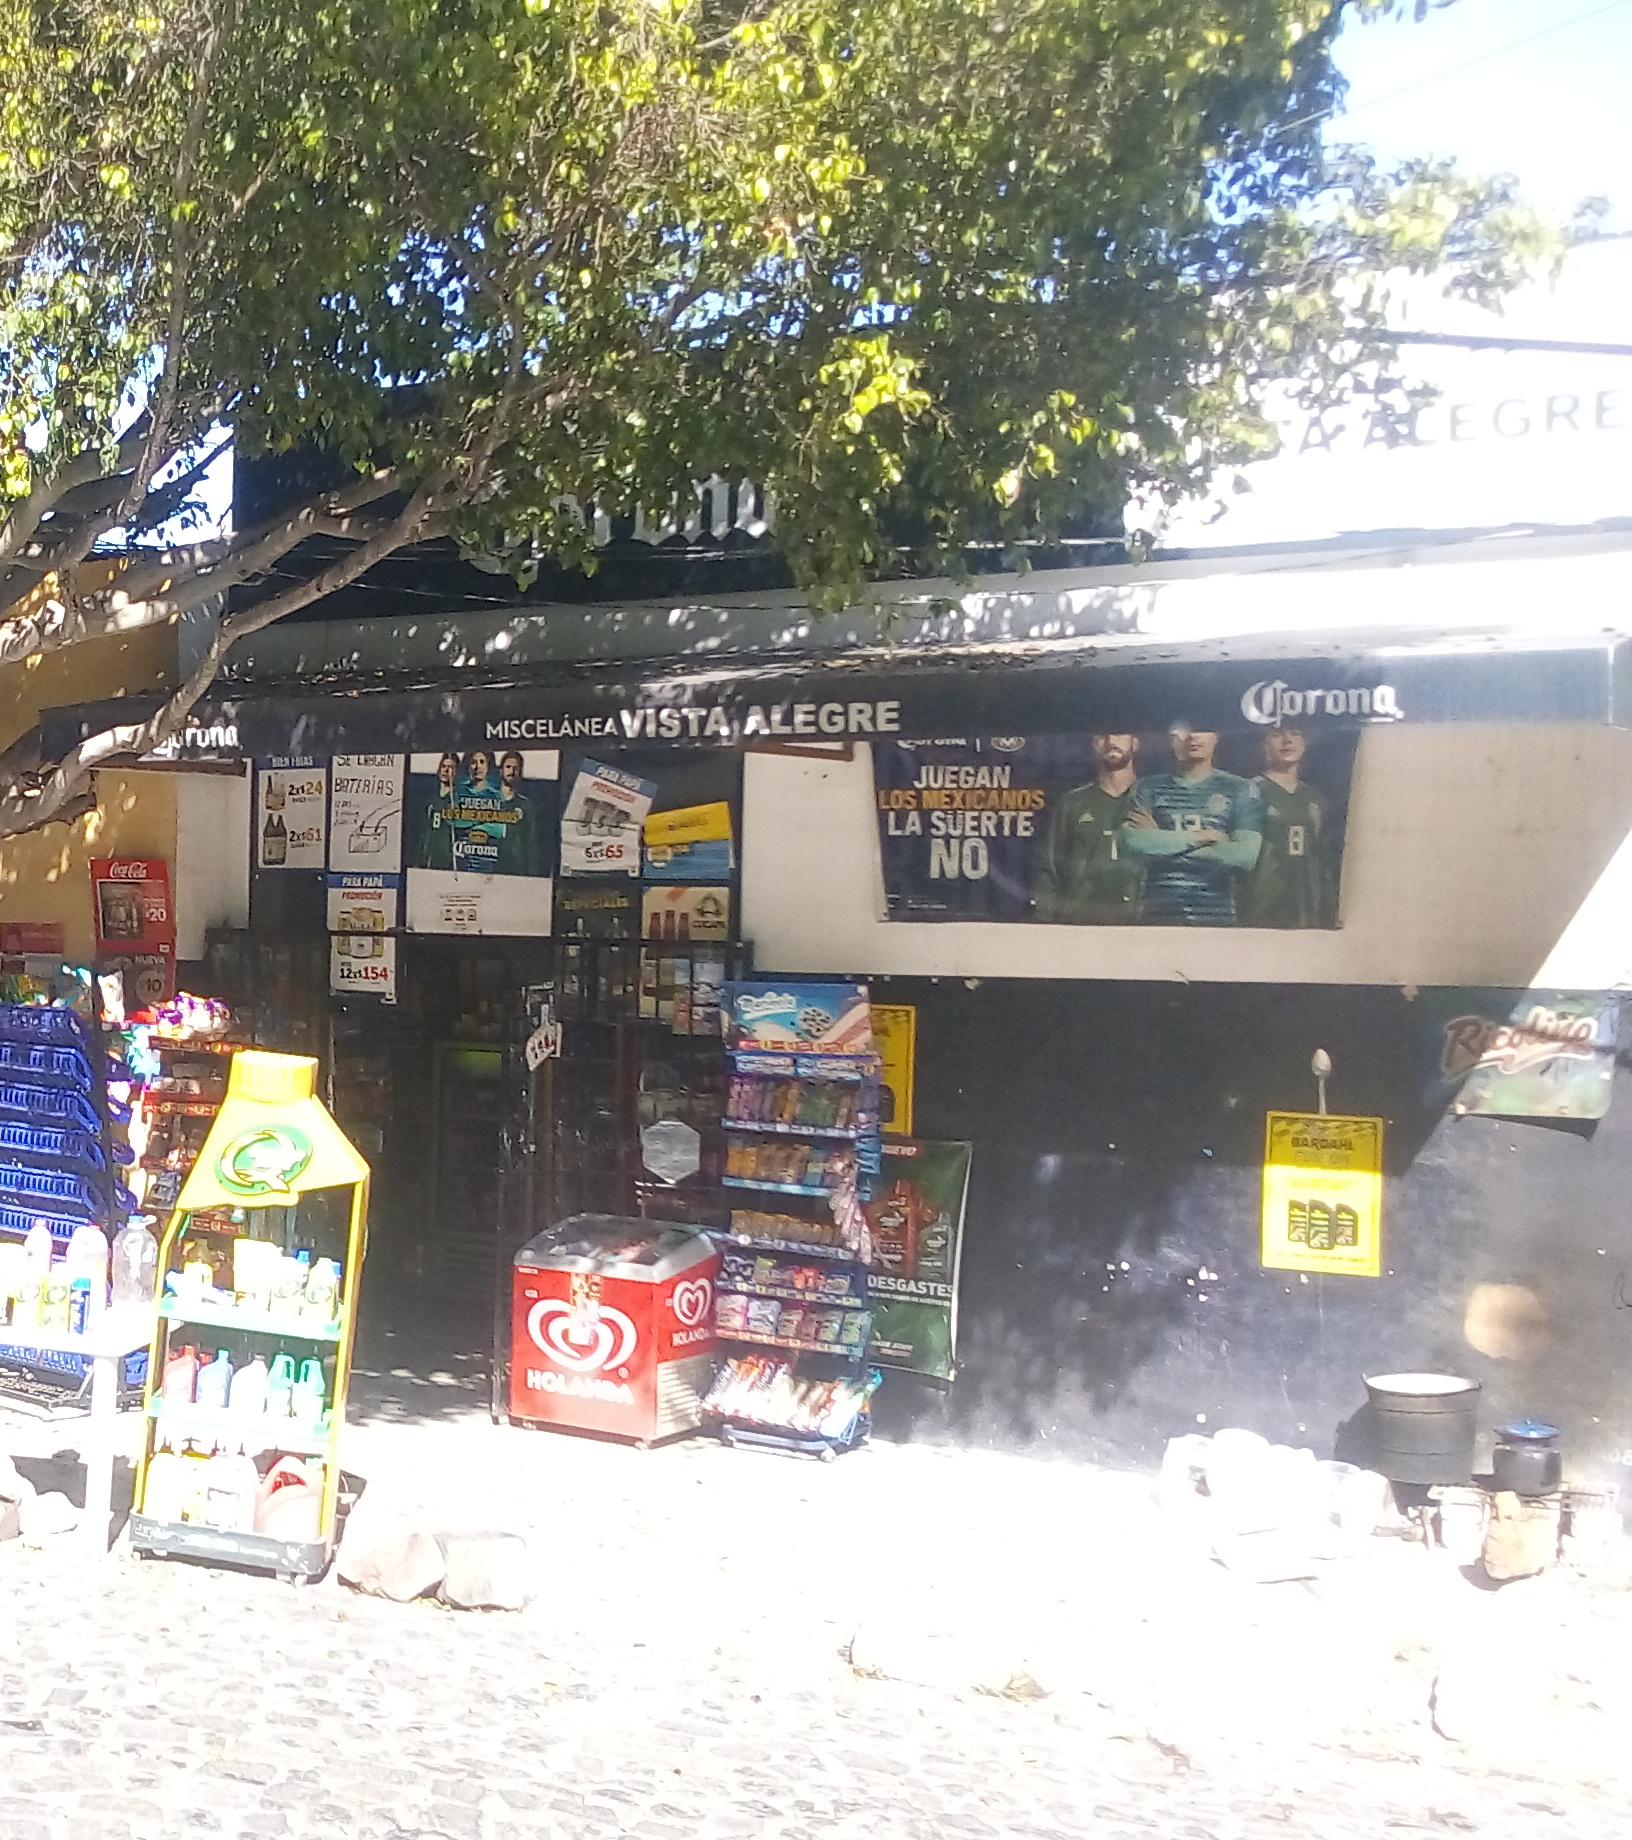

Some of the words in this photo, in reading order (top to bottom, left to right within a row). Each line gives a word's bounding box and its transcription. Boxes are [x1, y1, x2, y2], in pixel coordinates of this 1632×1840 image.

[1241, 680, 1398, 728] Corona
[486, 714, 619, 739] MISCELÁNEA
[620, 707, 730, 738] VISTA
[743, 700, 902, 735] ALEGRE
[913, 765, 1011, 789] JUEGAN
[461, 797, 502, 811] JUEGAN
[878, 790, 918, 810] LOS
[922, 789, 1046, 811] MEXICANOS
[888, 811, 922, 837] LA
[452, 840, 499, 858] Corona
[1288, 825, 1305, 856] 8
[929, 838, 989, 880] NO
[1291, 1136, 1353, 1150] BARDAHL
[526, 1369, 635, 1405] HOLANDA
